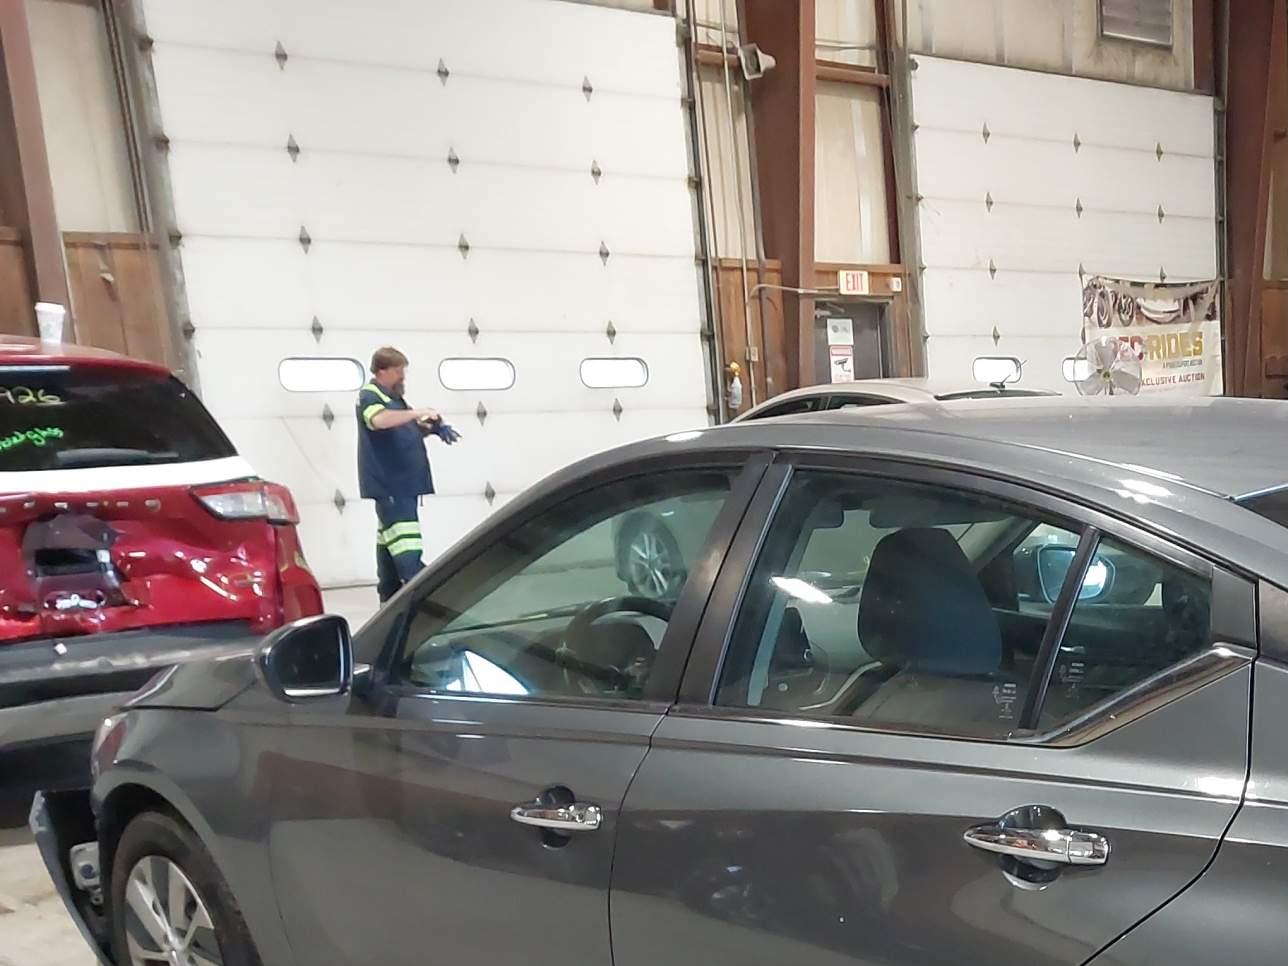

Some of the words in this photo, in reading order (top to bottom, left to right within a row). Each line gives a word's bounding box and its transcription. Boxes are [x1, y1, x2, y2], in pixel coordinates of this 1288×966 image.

[845, 271, 865, 292] EXIT
[1142, 375, 1177, 386] XCLUSIVE
[1178, 372, 1205, 383] AUCTION
